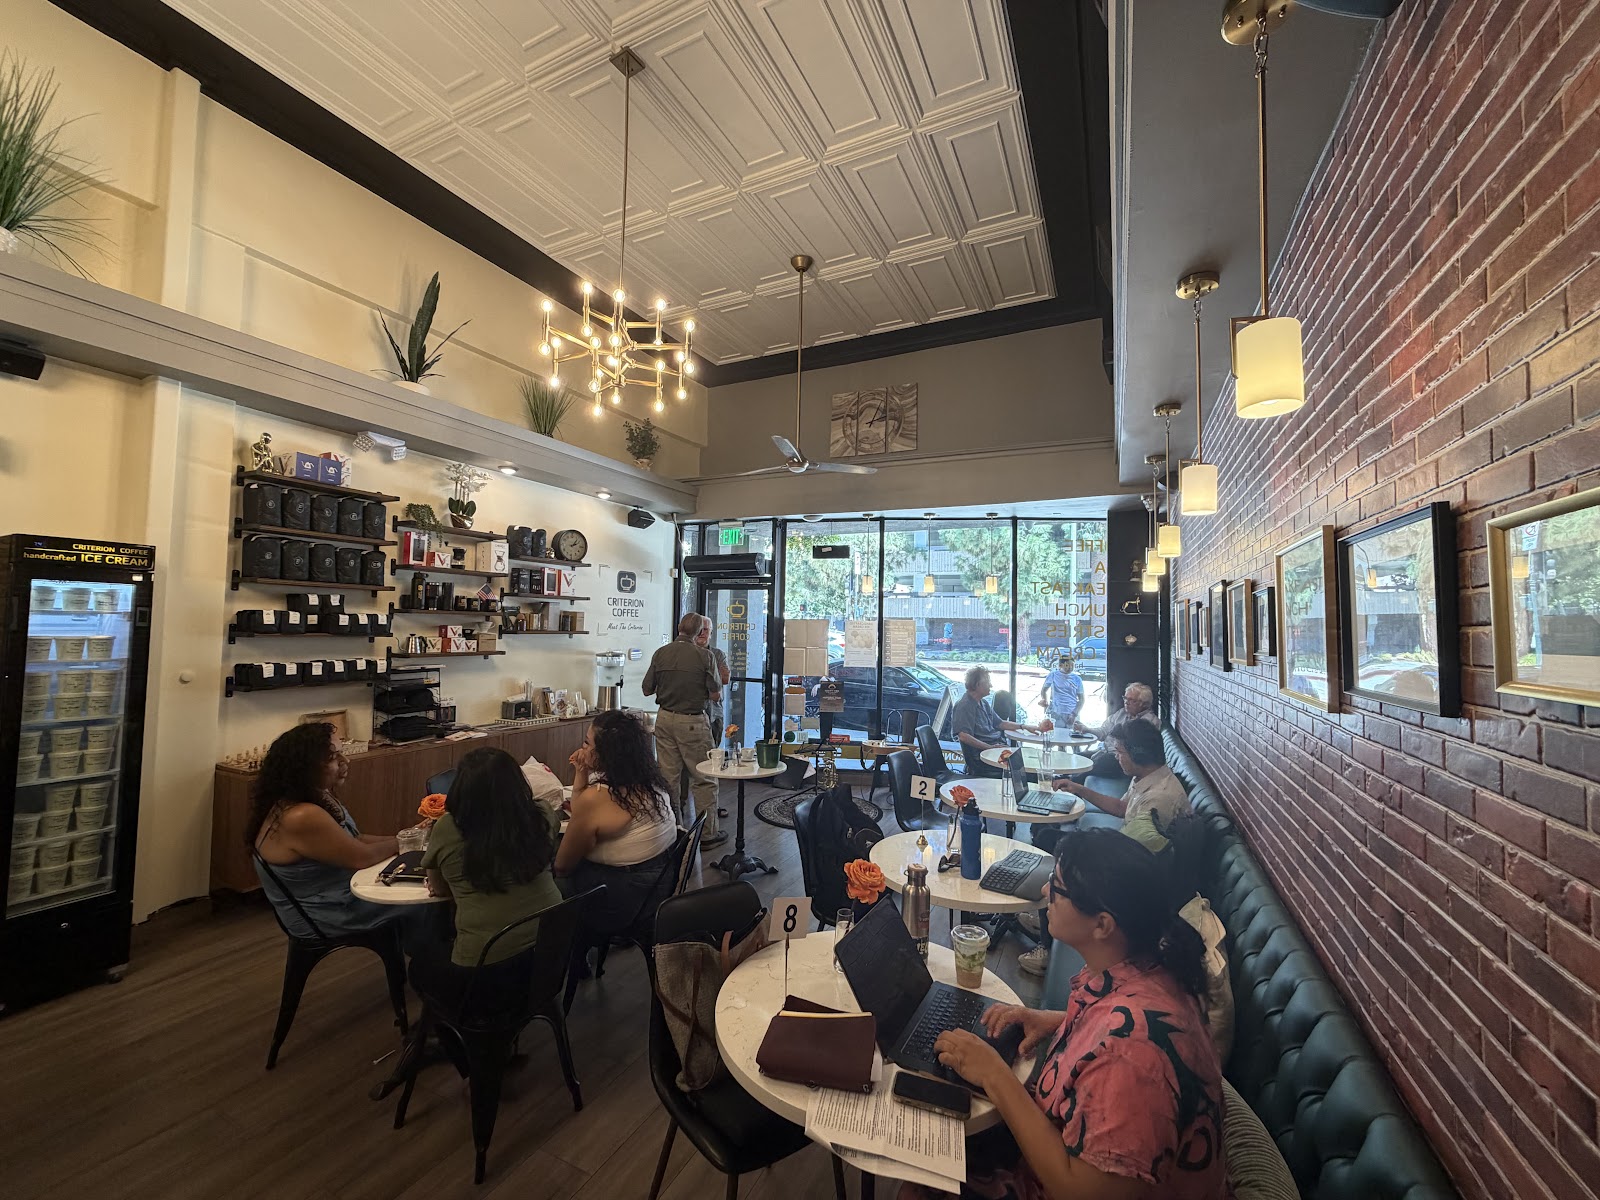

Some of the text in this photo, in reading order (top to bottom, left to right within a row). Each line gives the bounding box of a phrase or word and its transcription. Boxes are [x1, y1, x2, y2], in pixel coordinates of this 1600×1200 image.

[722, 528, 740, 545] EXIT
[72, 543, 149, 556] CRITERION COFFEE
[23, 551, 148, 566] handcrafted ICE CREAM
[607, 597, 645, 608] CRITERION
[612, 608, 640, 618] COFFEE
[918, 780, 928, 796] 2
[783, 904, 798, 933] 8
